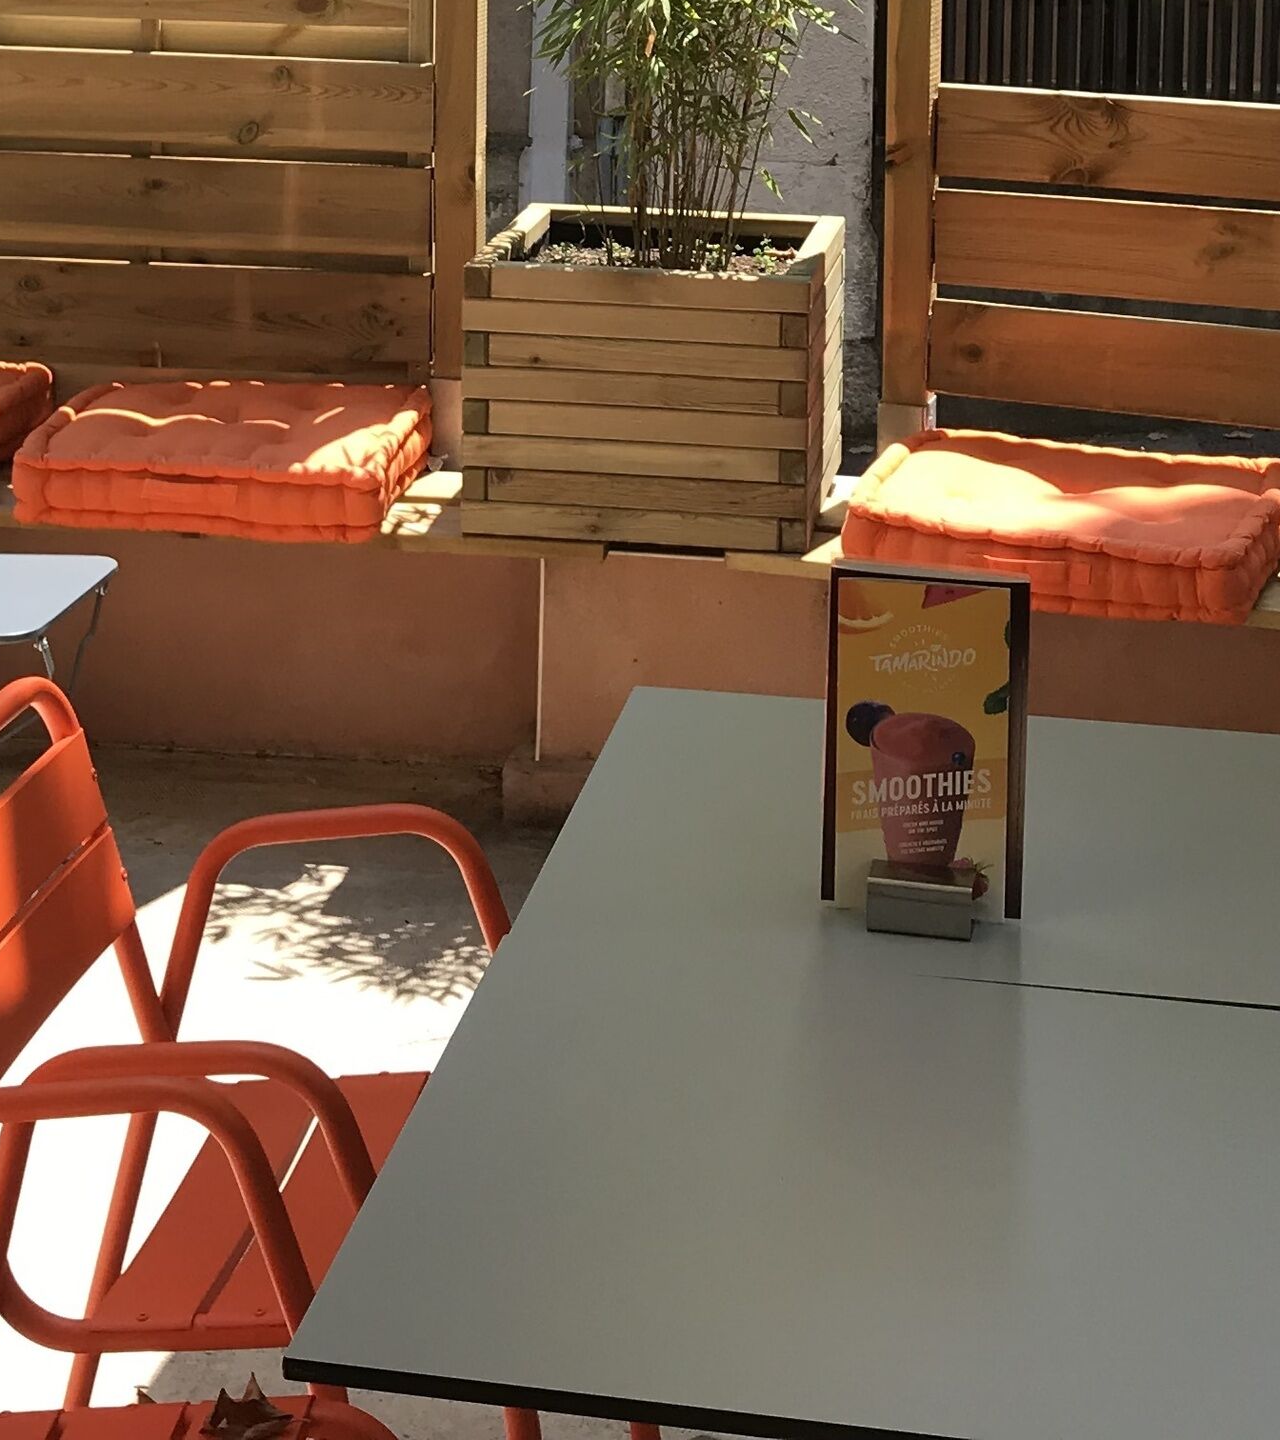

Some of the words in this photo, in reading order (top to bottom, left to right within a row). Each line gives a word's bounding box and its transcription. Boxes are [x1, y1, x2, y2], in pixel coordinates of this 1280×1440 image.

[851, 768, 992, 805] SMOOTHIES
[881, 801, 930, 818] PRÉPARÉS
[932, 799, 940, 813] À
[941, 801, 953, 813] LA
[955, 798, 992, 811] MINUTE
